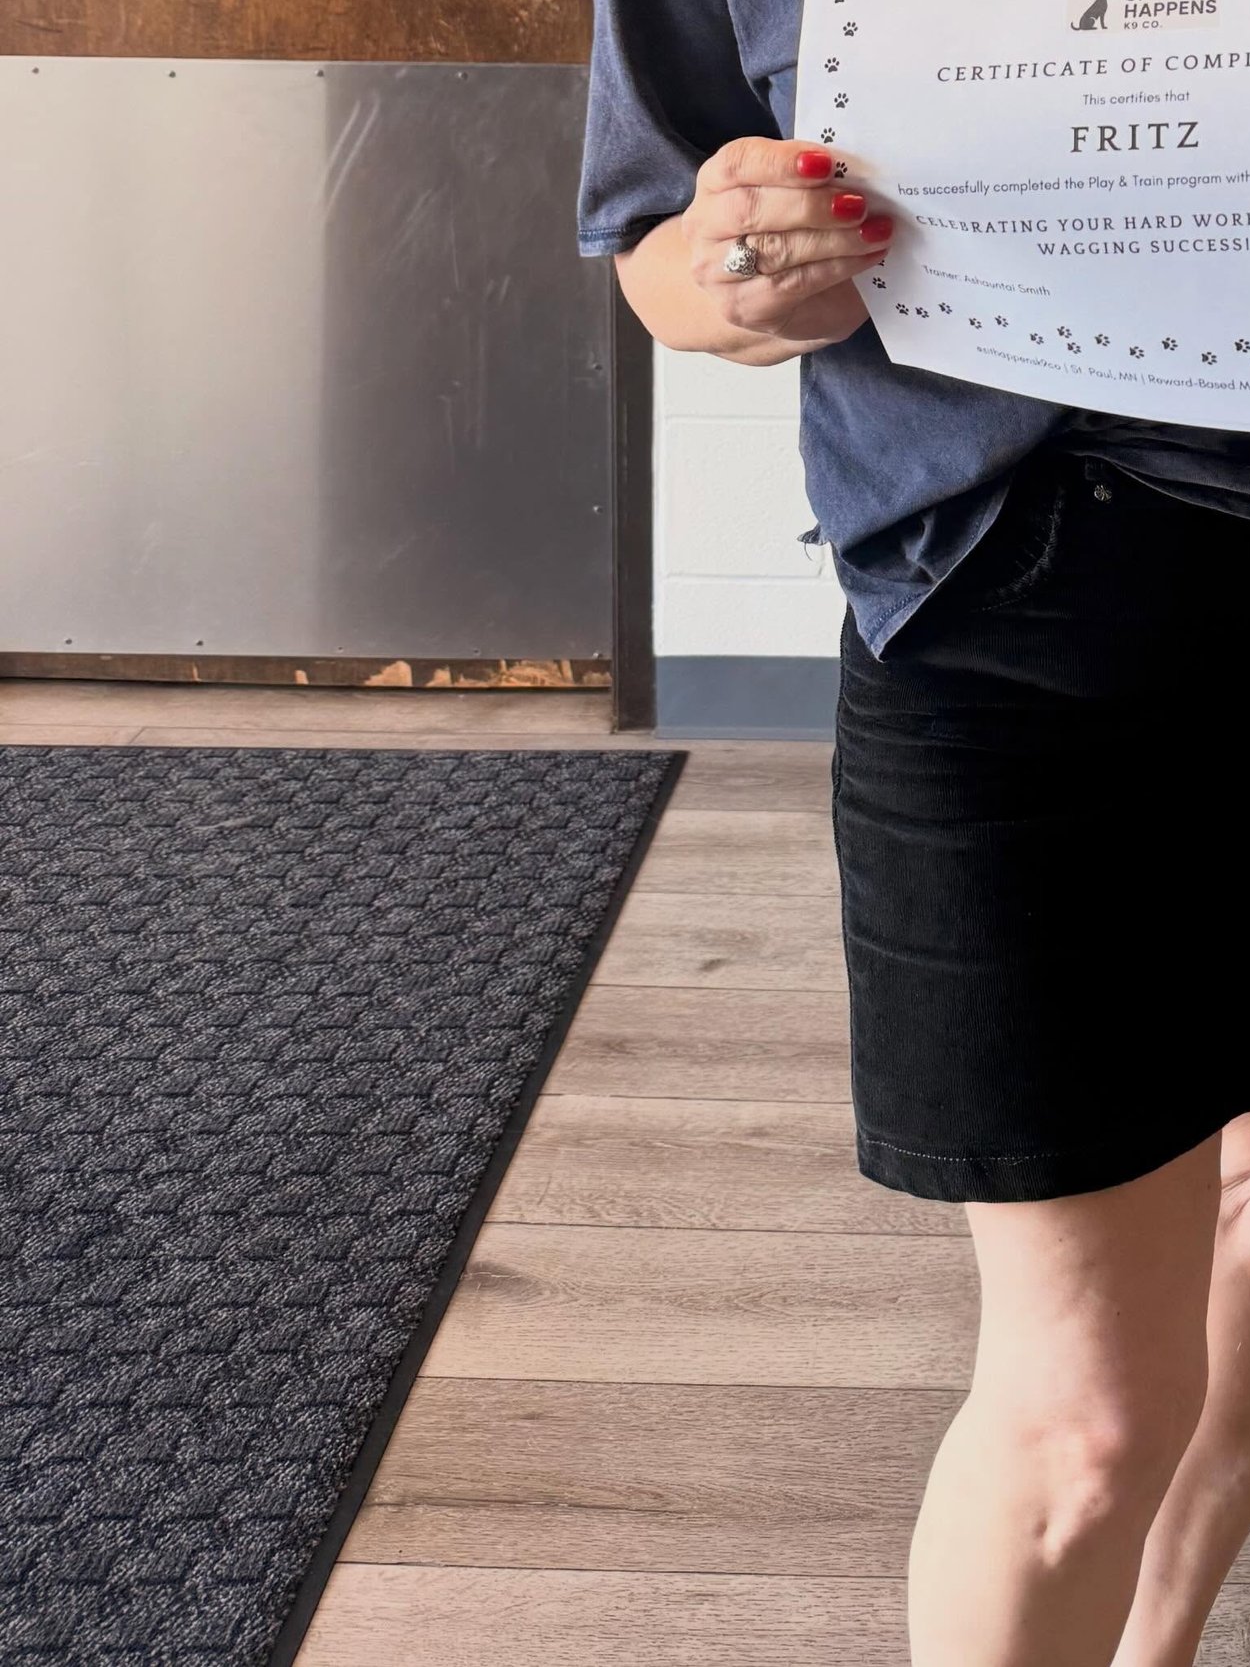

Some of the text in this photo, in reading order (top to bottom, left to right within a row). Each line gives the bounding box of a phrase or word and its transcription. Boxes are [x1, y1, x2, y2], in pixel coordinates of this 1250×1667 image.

[1124, 0, 1217, 19] HAPPENS
[1124, 20, 1163, 30] K9 CO.
[936, 59, 1108, 83] CERTIFICATE
[1120, 56, 1154, 74] OF
[1083, 89, 1190, 106] This certifies that
[1069, 121, 1200, 153] FRITZ
[898, 182, 920, 196] has
[922, 180, 990, 196] succesfully
[993, 177, 1060, 195] completed
[1065, 176, 1086, 190] the
[1088, 176, 1114, 191] Play
[1118, 175, 1128, 187] &
[1132, 173, 1163, 188] Train
[1167, 173, 1222, 189] program
[916, 215, 1048, 234] CELEBRATING
[1057, 217, 1115, 232] YOUR
[1124, 215, 1183, 230] HARD
[1037, 241, 1141, 256] WAGGING
[1018, 283, 1051, 297] Smith
[1088, 366, 1117, 381] Paul,
[1119, 372, 1138, 383] MN
[1148, 374, 1236, 391] Reward-Based
